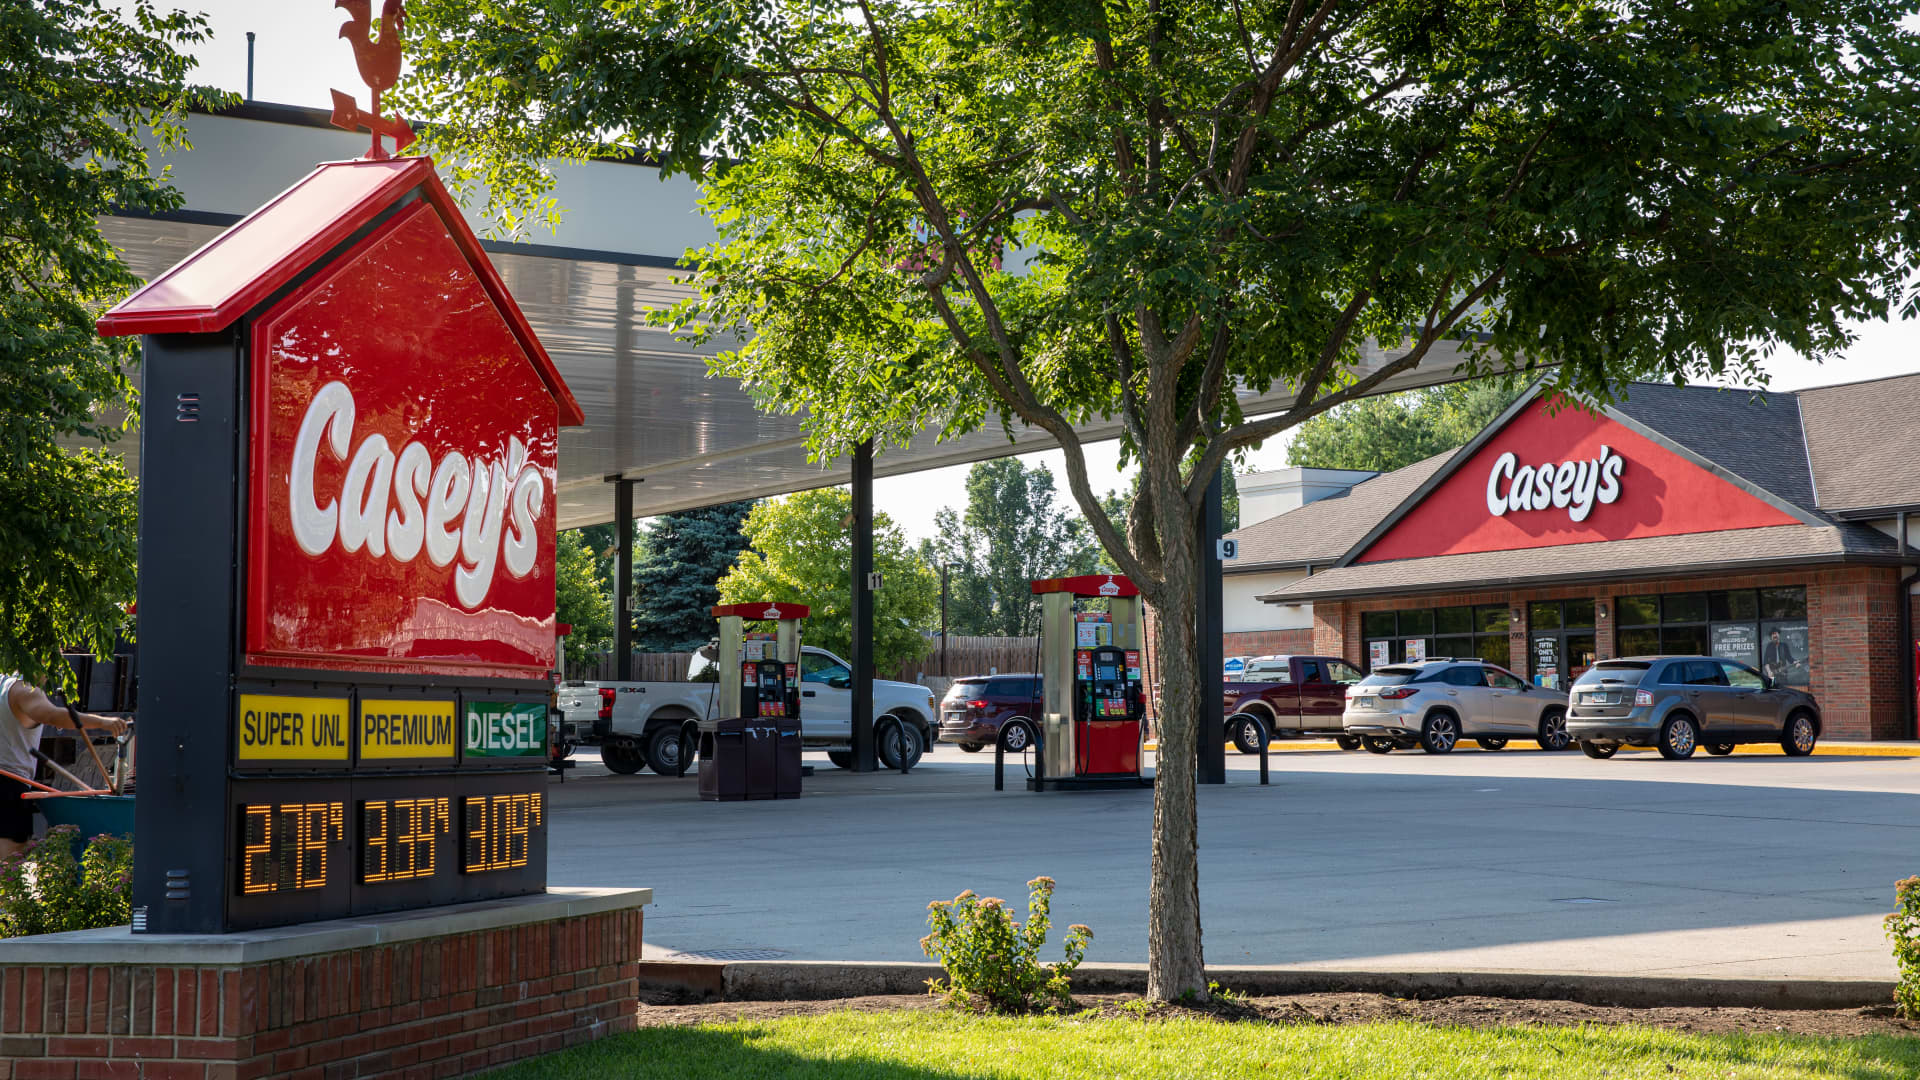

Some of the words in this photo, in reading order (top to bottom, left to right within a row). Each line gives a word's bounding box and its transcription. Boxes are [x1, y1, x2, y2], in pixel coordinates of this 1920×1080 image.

[289, 380, 544, 608] Casey's
[1487, 445, 1623, 522] Casey's
[1223, 541, 1234, 558] 9
[872, 573, 882, 588] 11
[1714, 643, 1731, 651] FREE
[1732, 642, 1755, 650] PRIZES
[244, 711, 304, 746] SUPER
[312, 712, 345, 747] UNL
[364, 714, 452, 746] PREMIUM
[467, 712, 541, 750] DIESEL
